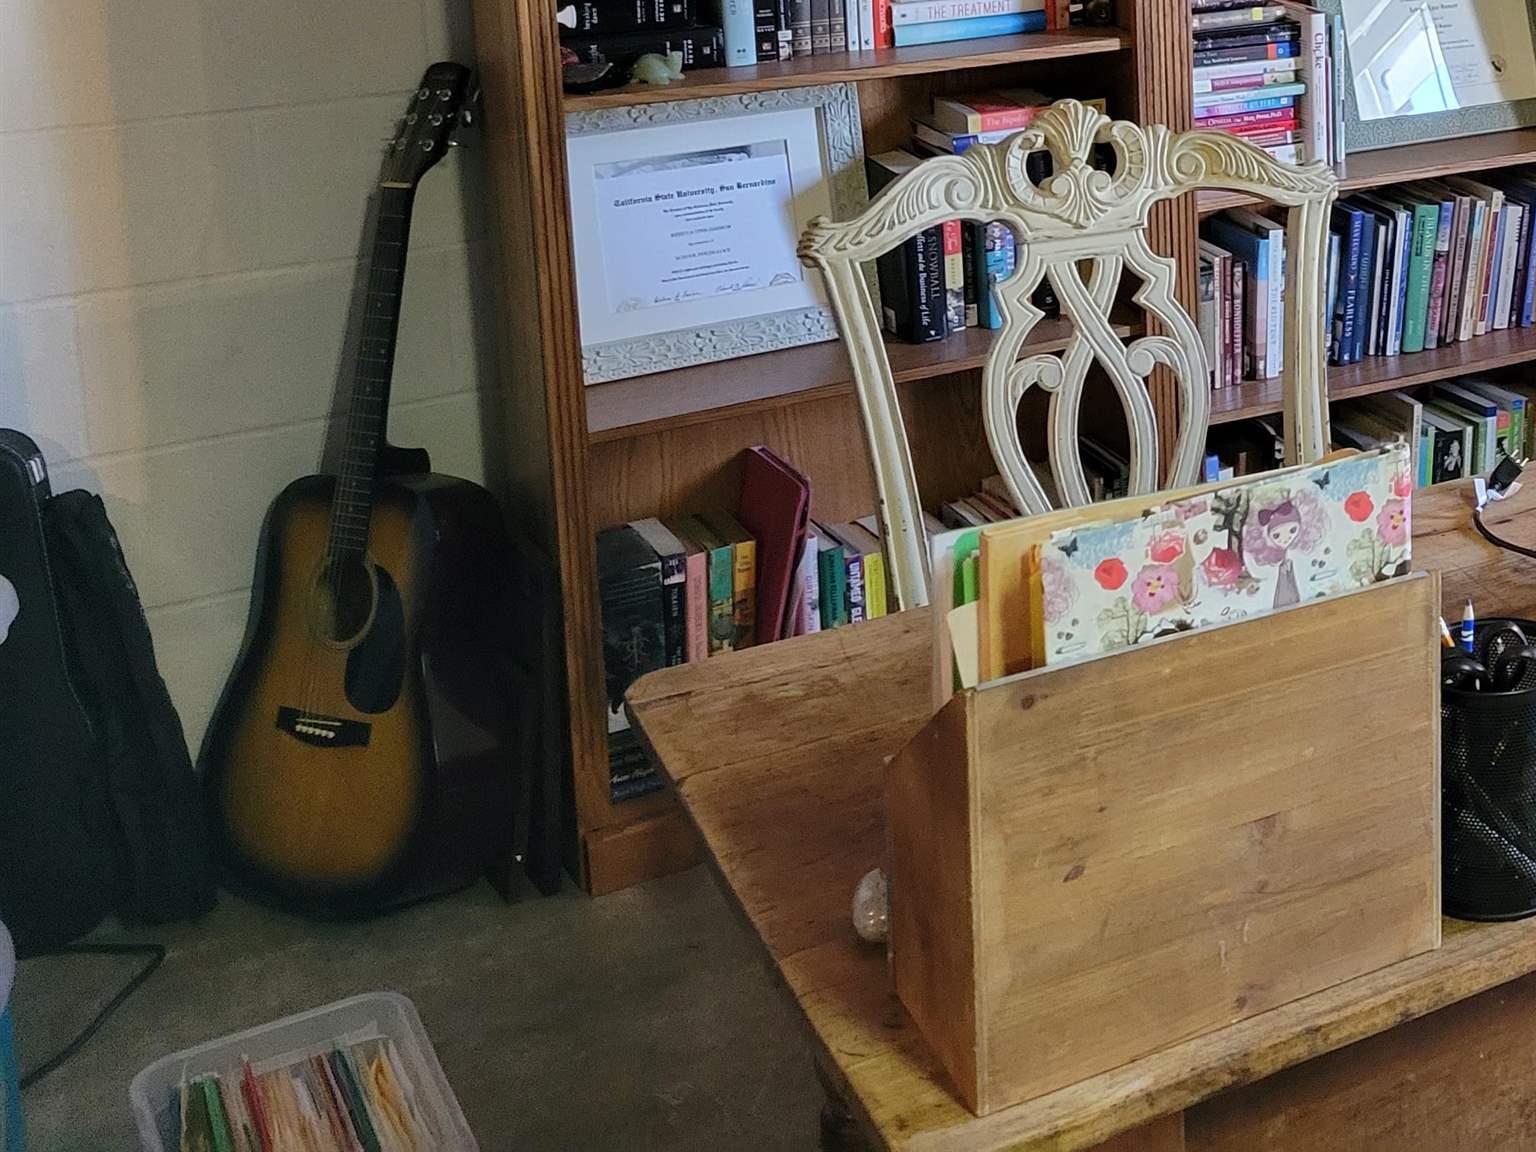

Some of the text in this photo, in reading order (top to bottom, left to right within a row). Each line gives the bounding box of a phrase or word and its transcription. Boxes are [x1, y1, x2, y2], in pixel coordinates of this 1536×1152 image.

[928, 0, 1011, 20] THE TREATMENT
[613, 196, 653, 208] California
[654, 192, 674, 201] State
[736, 178, 776, 190] Bernardino
[916, 234, 926, 252] ffett
[918, 253, 926, 263] and
[927, 235, 941, 301] SNOWBALL
[919, 273, 930, 303] Business
[921, 311, 931, 326] Life
[1344, 290, 1357, 337] FEARLESS
[849, 561, 862, 603] UNTAMED
[671, 587, 679, 617] TOLKIEN
